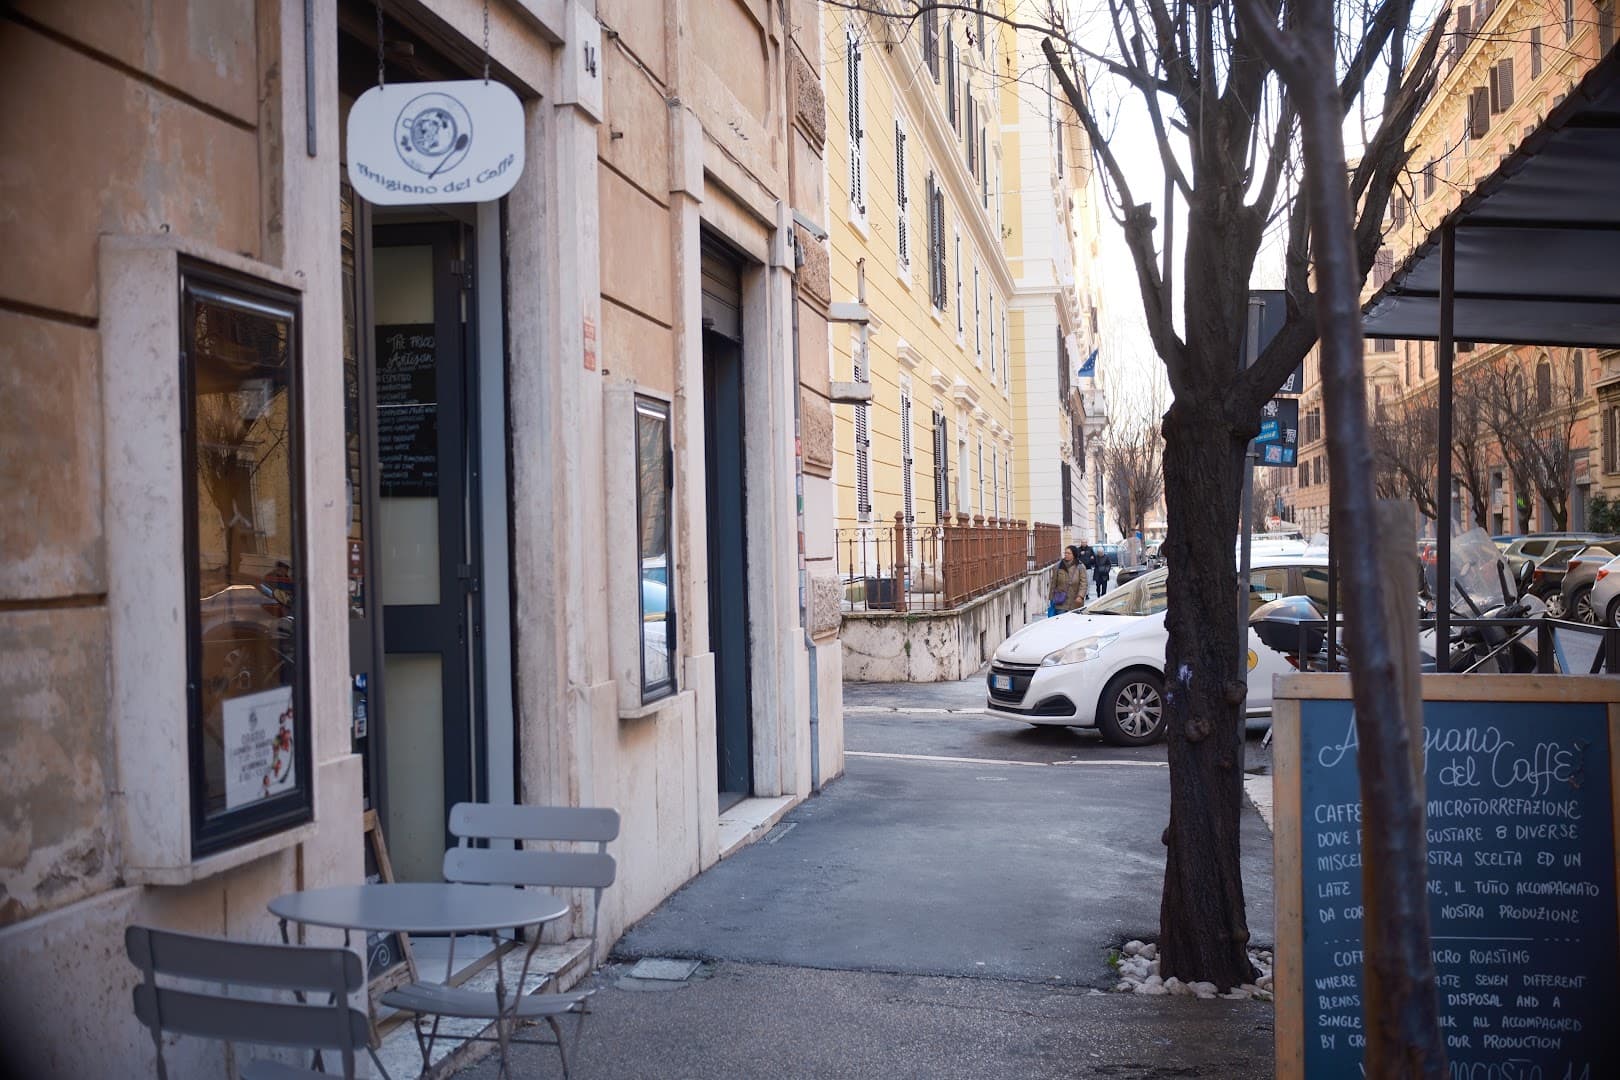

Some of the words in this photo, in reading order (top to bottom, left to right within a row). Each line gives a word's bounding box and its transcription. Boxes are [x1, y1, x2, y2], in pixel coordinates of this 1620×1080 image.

[584, 41, 596, 78] 14
[357, 162, 438, 194] Artigiano
[443, 178, 471, 192] del
[1427, 798, 1581, 820] MICROTORREFAZIONE
[1317, 831, 1350, 848] DOVE
[1496, 825, 1507, 839] 8
[1516, 824, 1578, 840] DIVERSE
[1475, 851, 1523, 867] SCELTA
[1537, 851, 1555, 867] ED
[1564, 853, 1582, 867] UN
[1318, 881, 1351, 897] LATTE
[1455, 881, 1466, 894] IL
[1474, 880, 1509, 896] TUTTO
[1517, 881, 1600, 897] ACCOMPAGNATO
[1319, 908, 1336, 923] DA
[1441, 904, 1484, 920] NOSTRA
[1499, 905, 1580, 924] PRODUZIONE
[1430, 949, 1461, 964] ICRO
[1470, 949, 1530, 965] ROASTING
[1315, 975, 1357, 990] WHERE
[1475, 974, 1509, 987] SEVEN
[1523, 974, 1586, 989] DIFFERENT
[1319, 995, 1361, 1010] BLENDS
[1448, 992, 1503, 1007] DISPOSAL
[1516, 995, 1540, 1008] AND
[1553, 996, 1561, 1008] A
[1319, 1015, 1362, 1029] SINGLE
[1473, 1016, 1490, 1028] ALL
[1502, 1016, 1583, 1032] ACCOMPAGNED
[1320, 1035, 1335, 1050] BY
[1447, 1034, 1472, 1049] OUR
[1483, 1034, 1562, 1050] PRODUCTION
